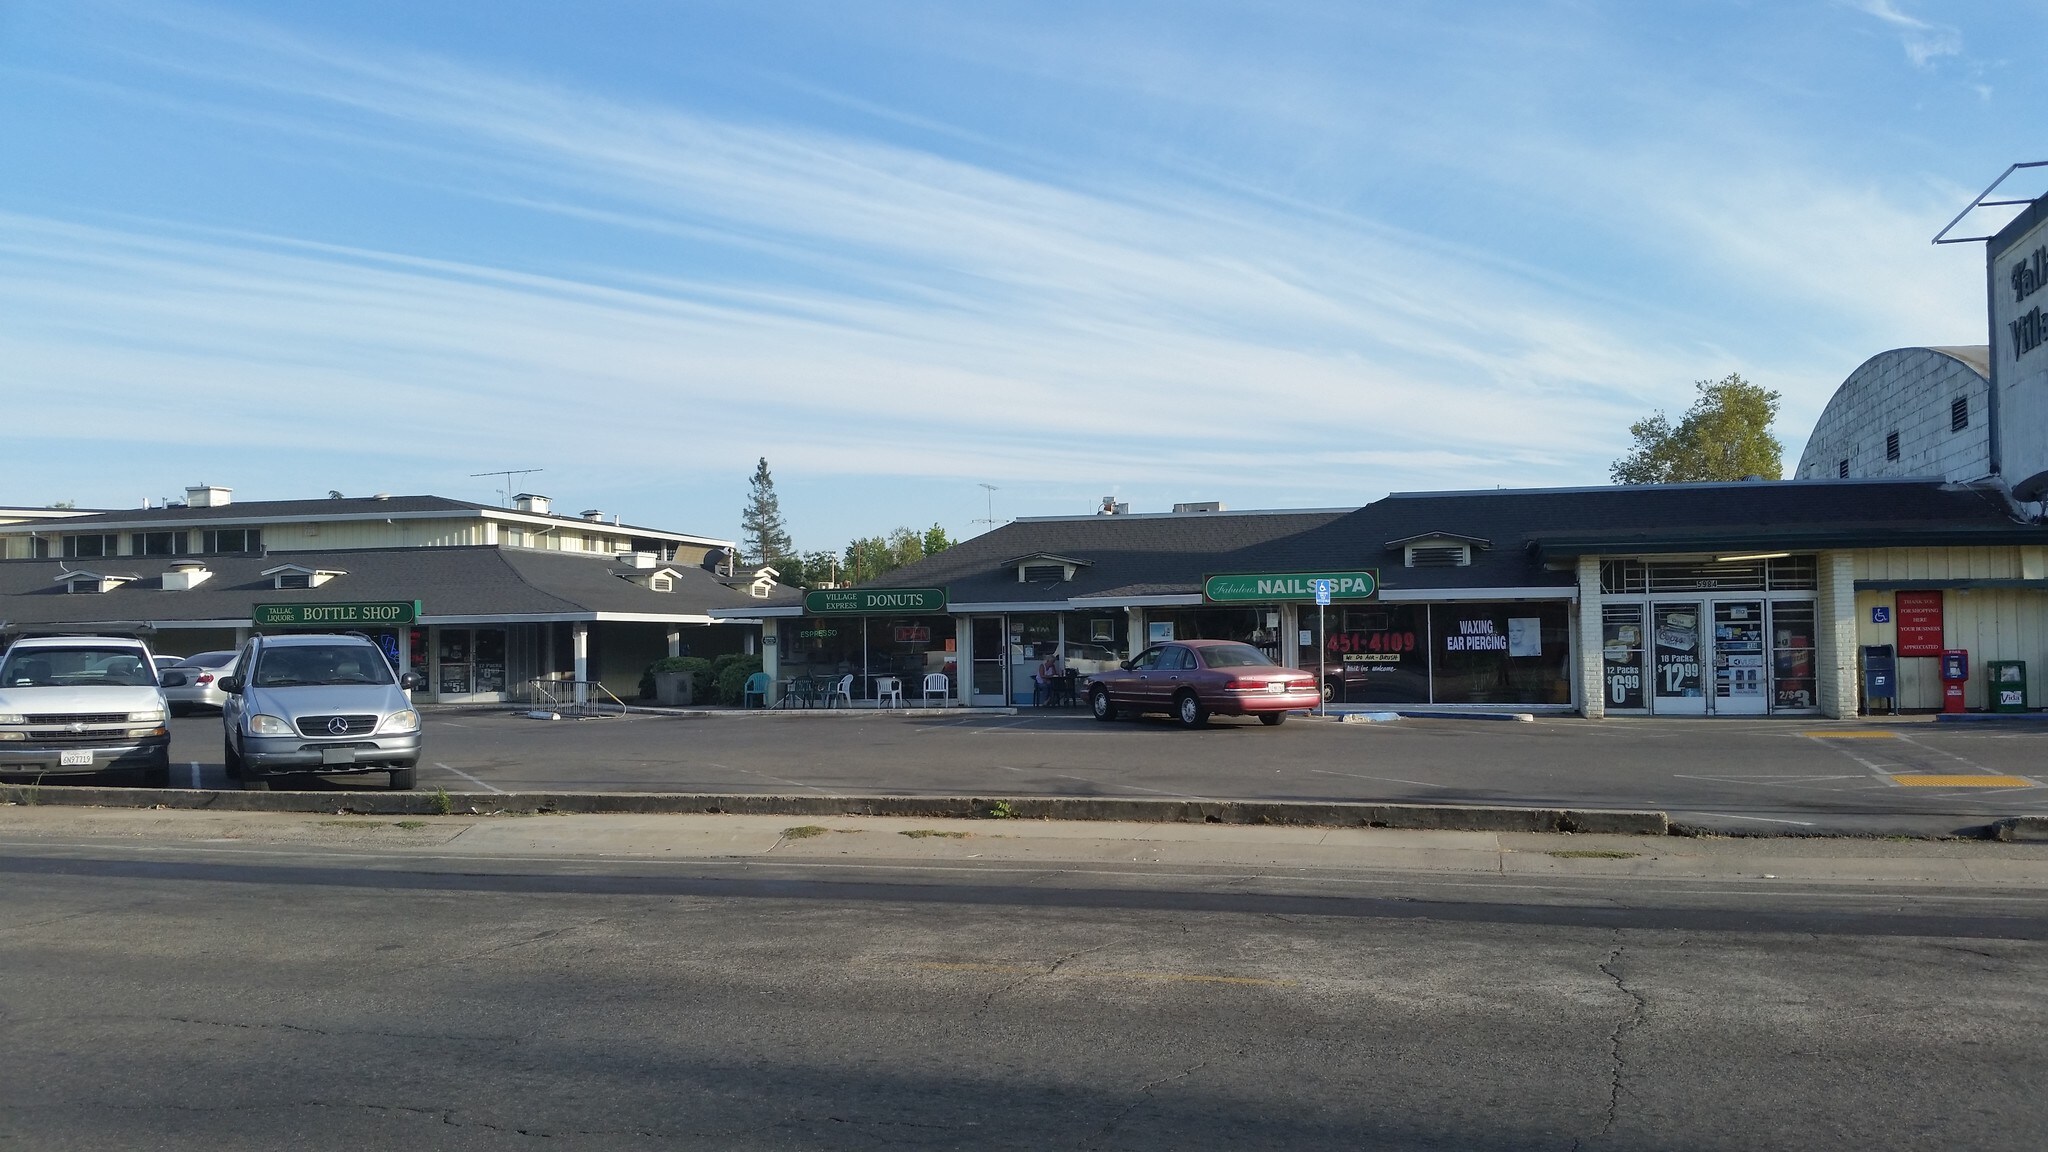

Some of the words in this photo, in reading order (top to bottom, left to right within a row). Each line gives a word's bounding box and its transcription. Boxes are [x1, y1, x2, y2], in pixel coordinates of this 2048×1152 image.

[1213, 582, 1256, 594] Fabulous
[1257, 579, 1316, 594] NAILS
[1696, 580, 1717, 588] 5984
[826, 593, 857, 601] VILLAGE
[867, 594, 924, 607] DONUTS
[826, 602, 857, 610] EXPRESS
[268, 607, 292, 615] TALLAC
[303, 607, 357, 620] BOTTLE
[362, 606, 401, 619] SHOP
[267, 614, 295, 622] LIQUORS
[1459, 620, 1493, 634] WAXING
[800, 629, 838, 638] ESPRESSO
[1447, 636, 1464, 650] EAR
[1466, 635, 1507, 650] PIERCING
[1671, 654, 1694, 662] Packs
[1606, 666, 1615, 674] 12
[1616, 666, 1639, 674] Packs
